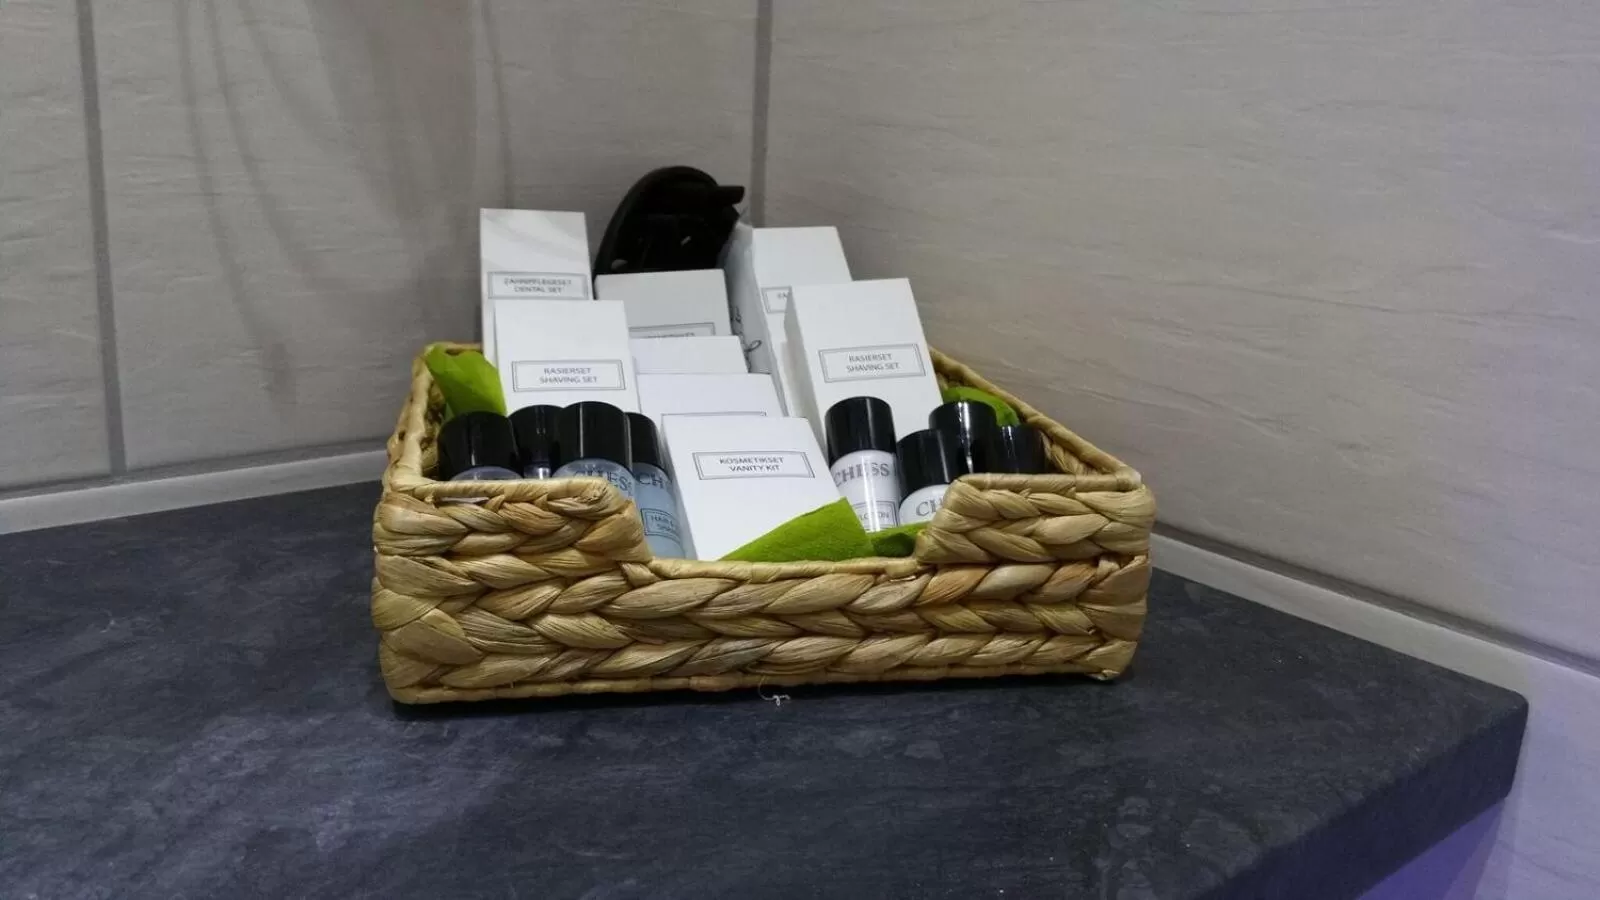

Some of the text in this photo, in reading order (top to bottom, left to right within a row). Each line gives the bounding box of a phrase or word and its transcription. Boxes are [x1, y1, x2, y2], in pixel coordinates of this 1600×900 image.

[848, 353, 893, 363] RASIERSET
[543, 367, 592, 376] RASIERSET
[846, 362, 900, 373] SHAVING SET
[539, 375, 597, 384] SHAVING SET
[719, 456, 785, 465] KOSMETIKSET
[728, 464, 781, 473] VANITY KIT
[833, 462, 890, 488] CHESS
